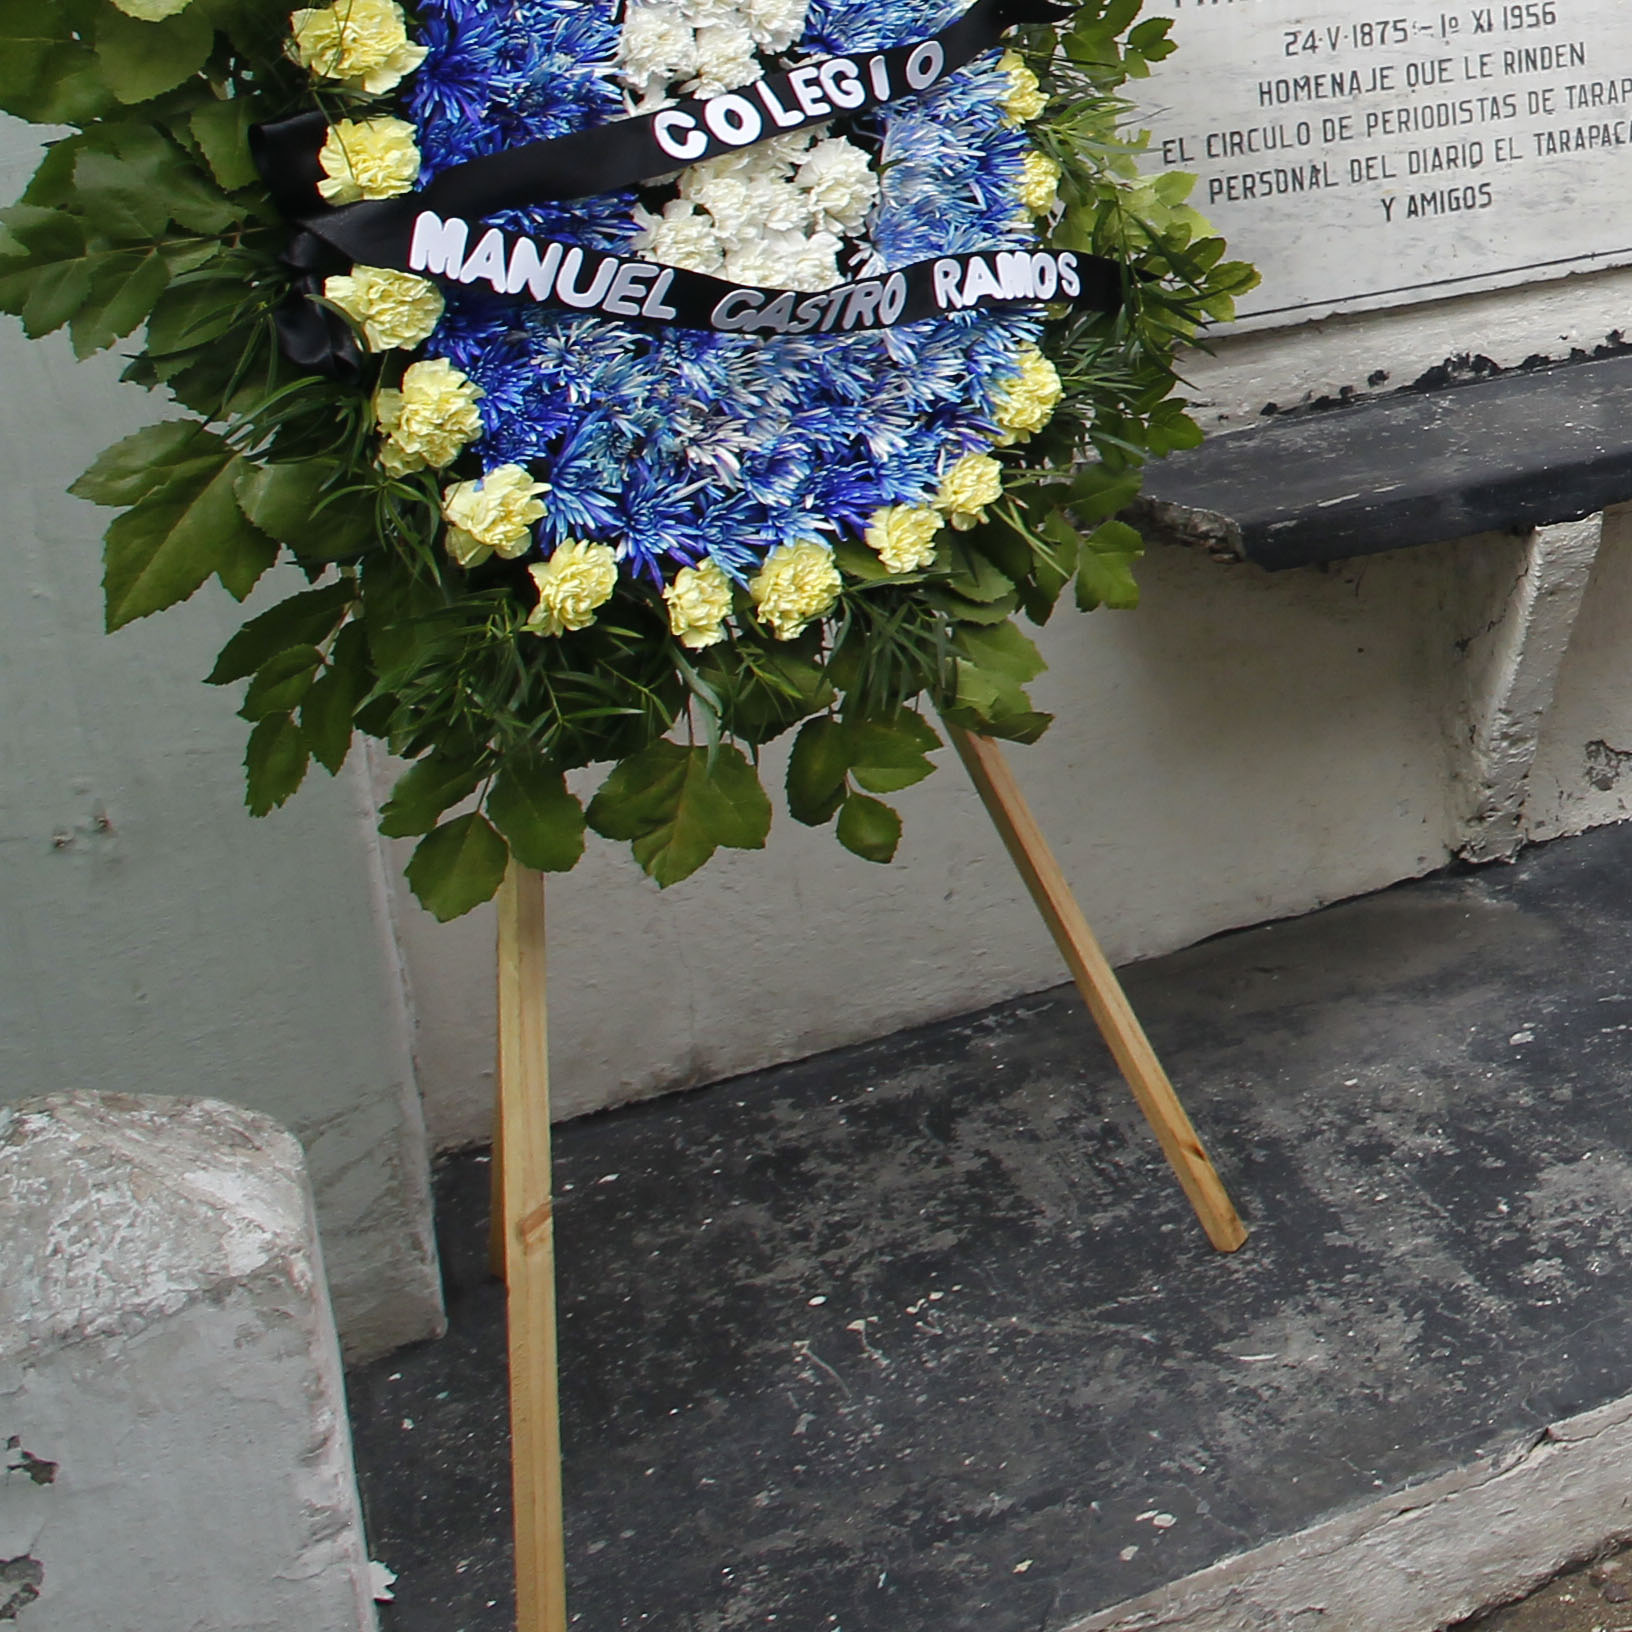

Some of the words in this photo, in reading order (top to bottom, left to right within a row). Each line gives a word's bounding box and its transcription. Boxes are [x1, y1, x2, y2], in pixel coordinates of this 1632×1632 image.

[1502, 0, 1558, 32] 1956
[652, 39, 946, 161] COLEGIO
[1258, 65, 1395, 107] HOMENAJE
[1405, 57, 1455, 95] QUE
[1463, 52, 1494, 81] LE
[1503, 40, 1587, 76] RINDEN
[1161, 136, 1196, 167] EL
[1205, 120, 1312, 159] CIRCULO
[1322, 114, 1354, 144] DE
[1365, 92, 1518, 139] PERIODISTAS
[1527, 87, 1557, 116] DE
[1208, 160, 1340, 206] PERSONAL
[1349, 153, 1398, 185] DEL
[1407, 141, 1485, 177] DIARIO
[1494, 135, 1524, 164] EL
[1380, 196, 1396, 224] Y
[1406, 181, 1493, 220] AMIGOS
[408, 209, 678, 323] MANUEL
[932, 250, 1083, 310] RAMOS
